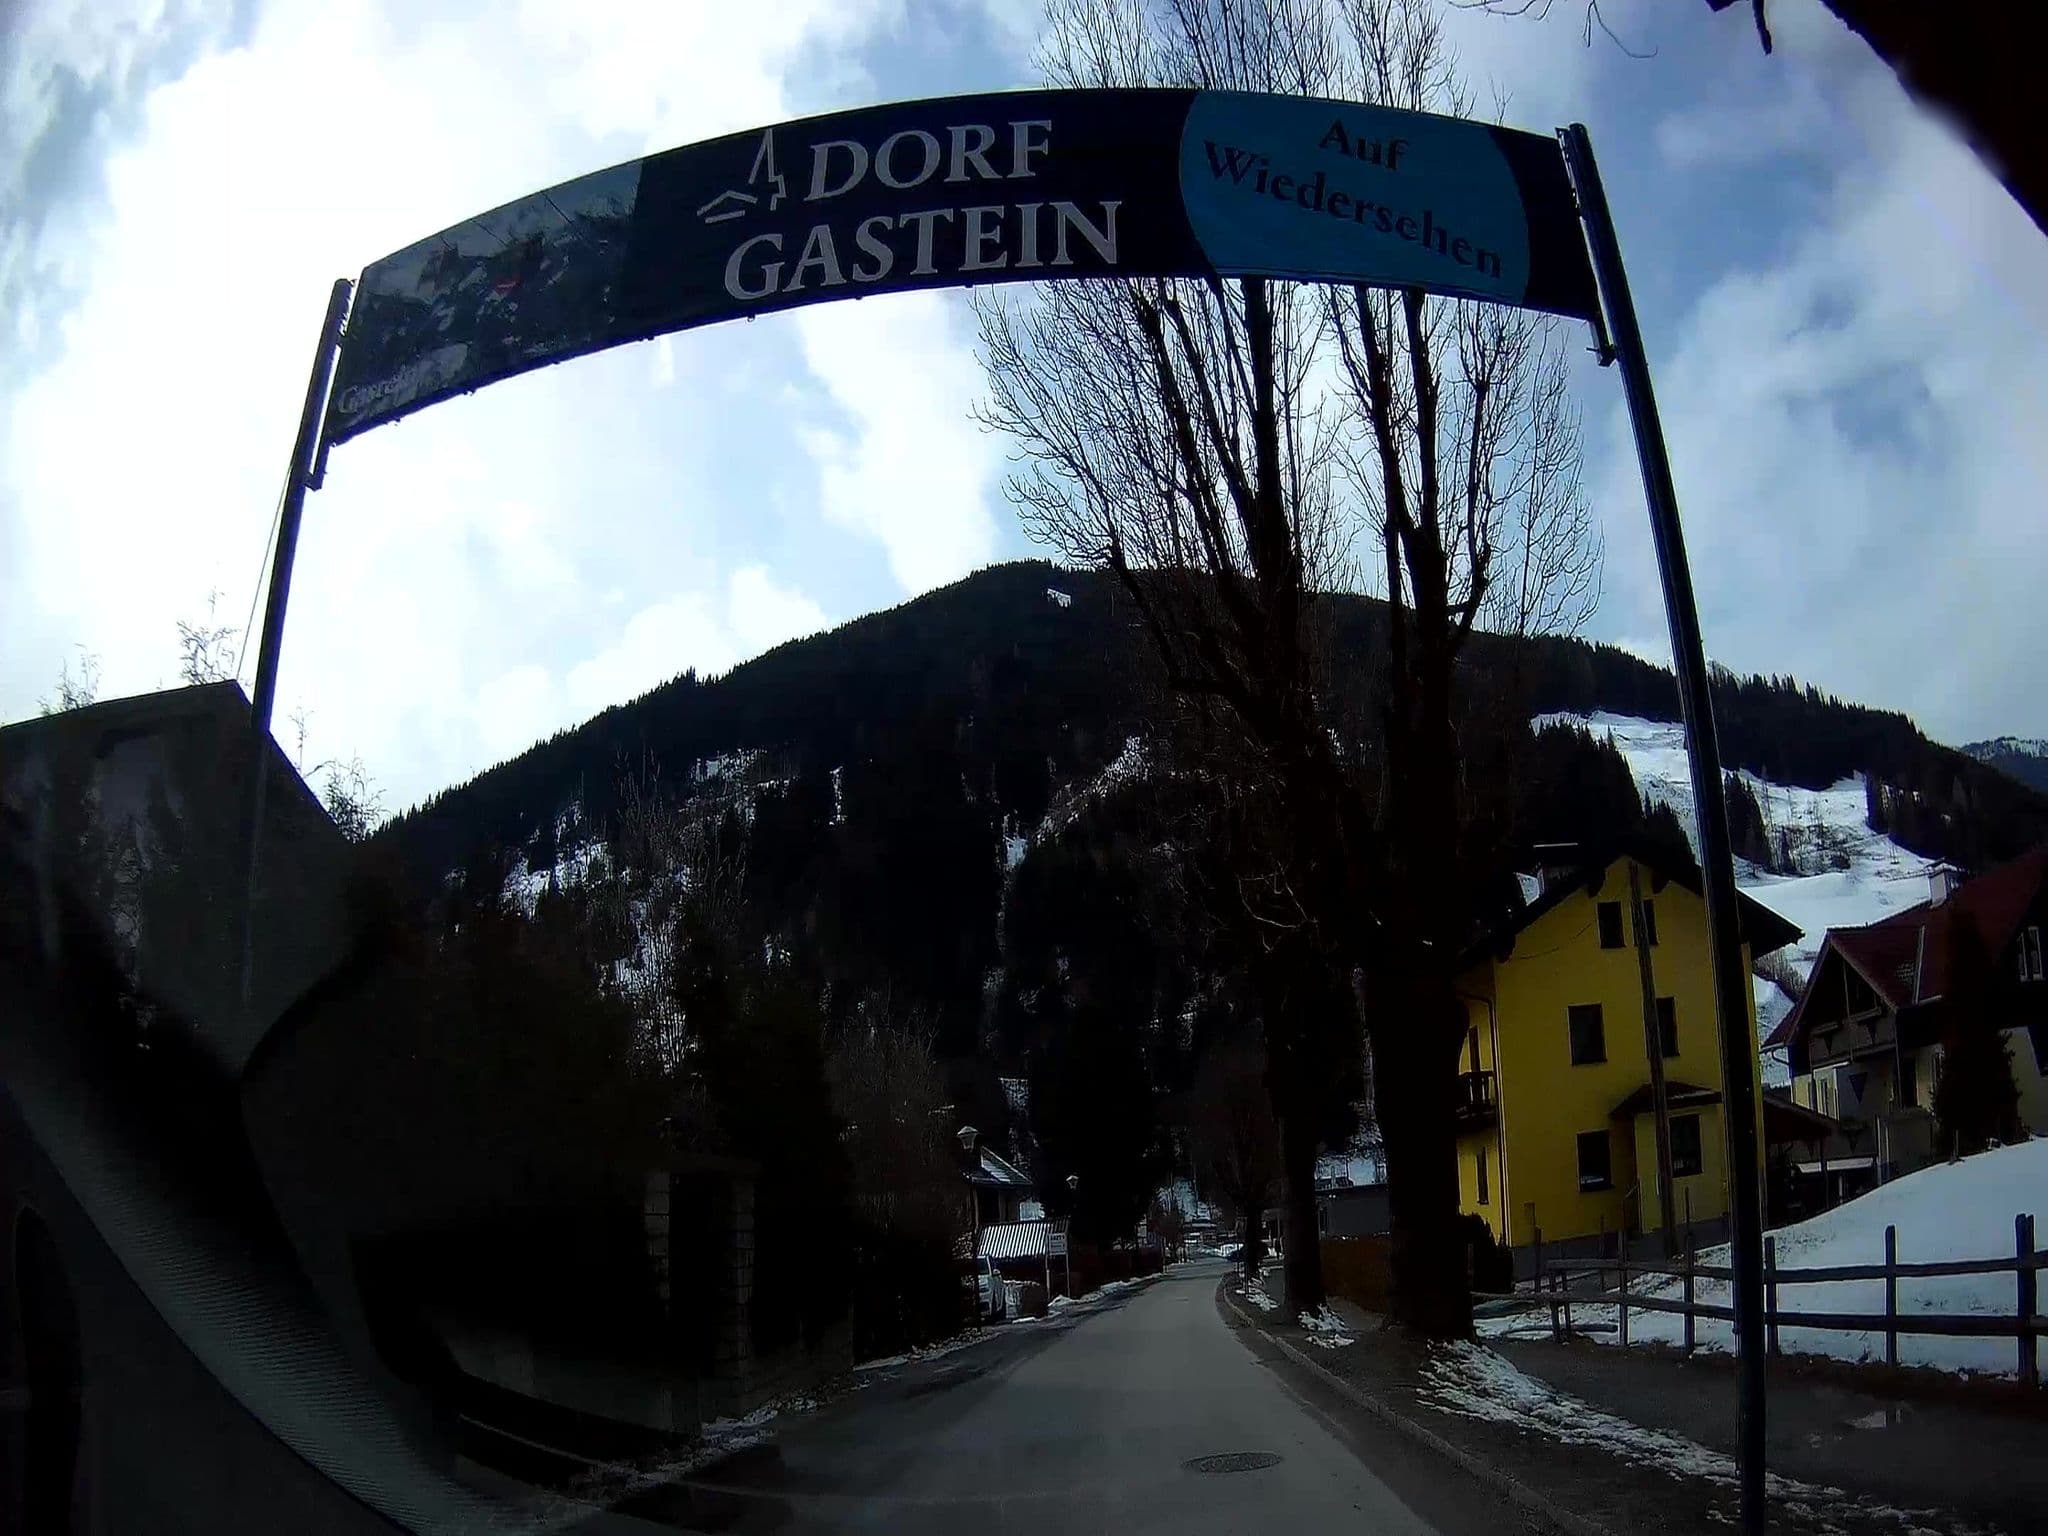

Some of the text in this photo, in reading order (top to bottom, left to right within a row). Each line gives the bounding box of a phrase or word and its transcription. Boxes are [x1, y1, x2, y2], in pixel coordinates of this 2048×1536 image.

[804, 119, 1053, 201] DORF
[1319, 118, 1410, 170] Auf
[724, 201, 1122, 300] GASTEIN
[1204, 139, 1503, 278] Wiedersehen
